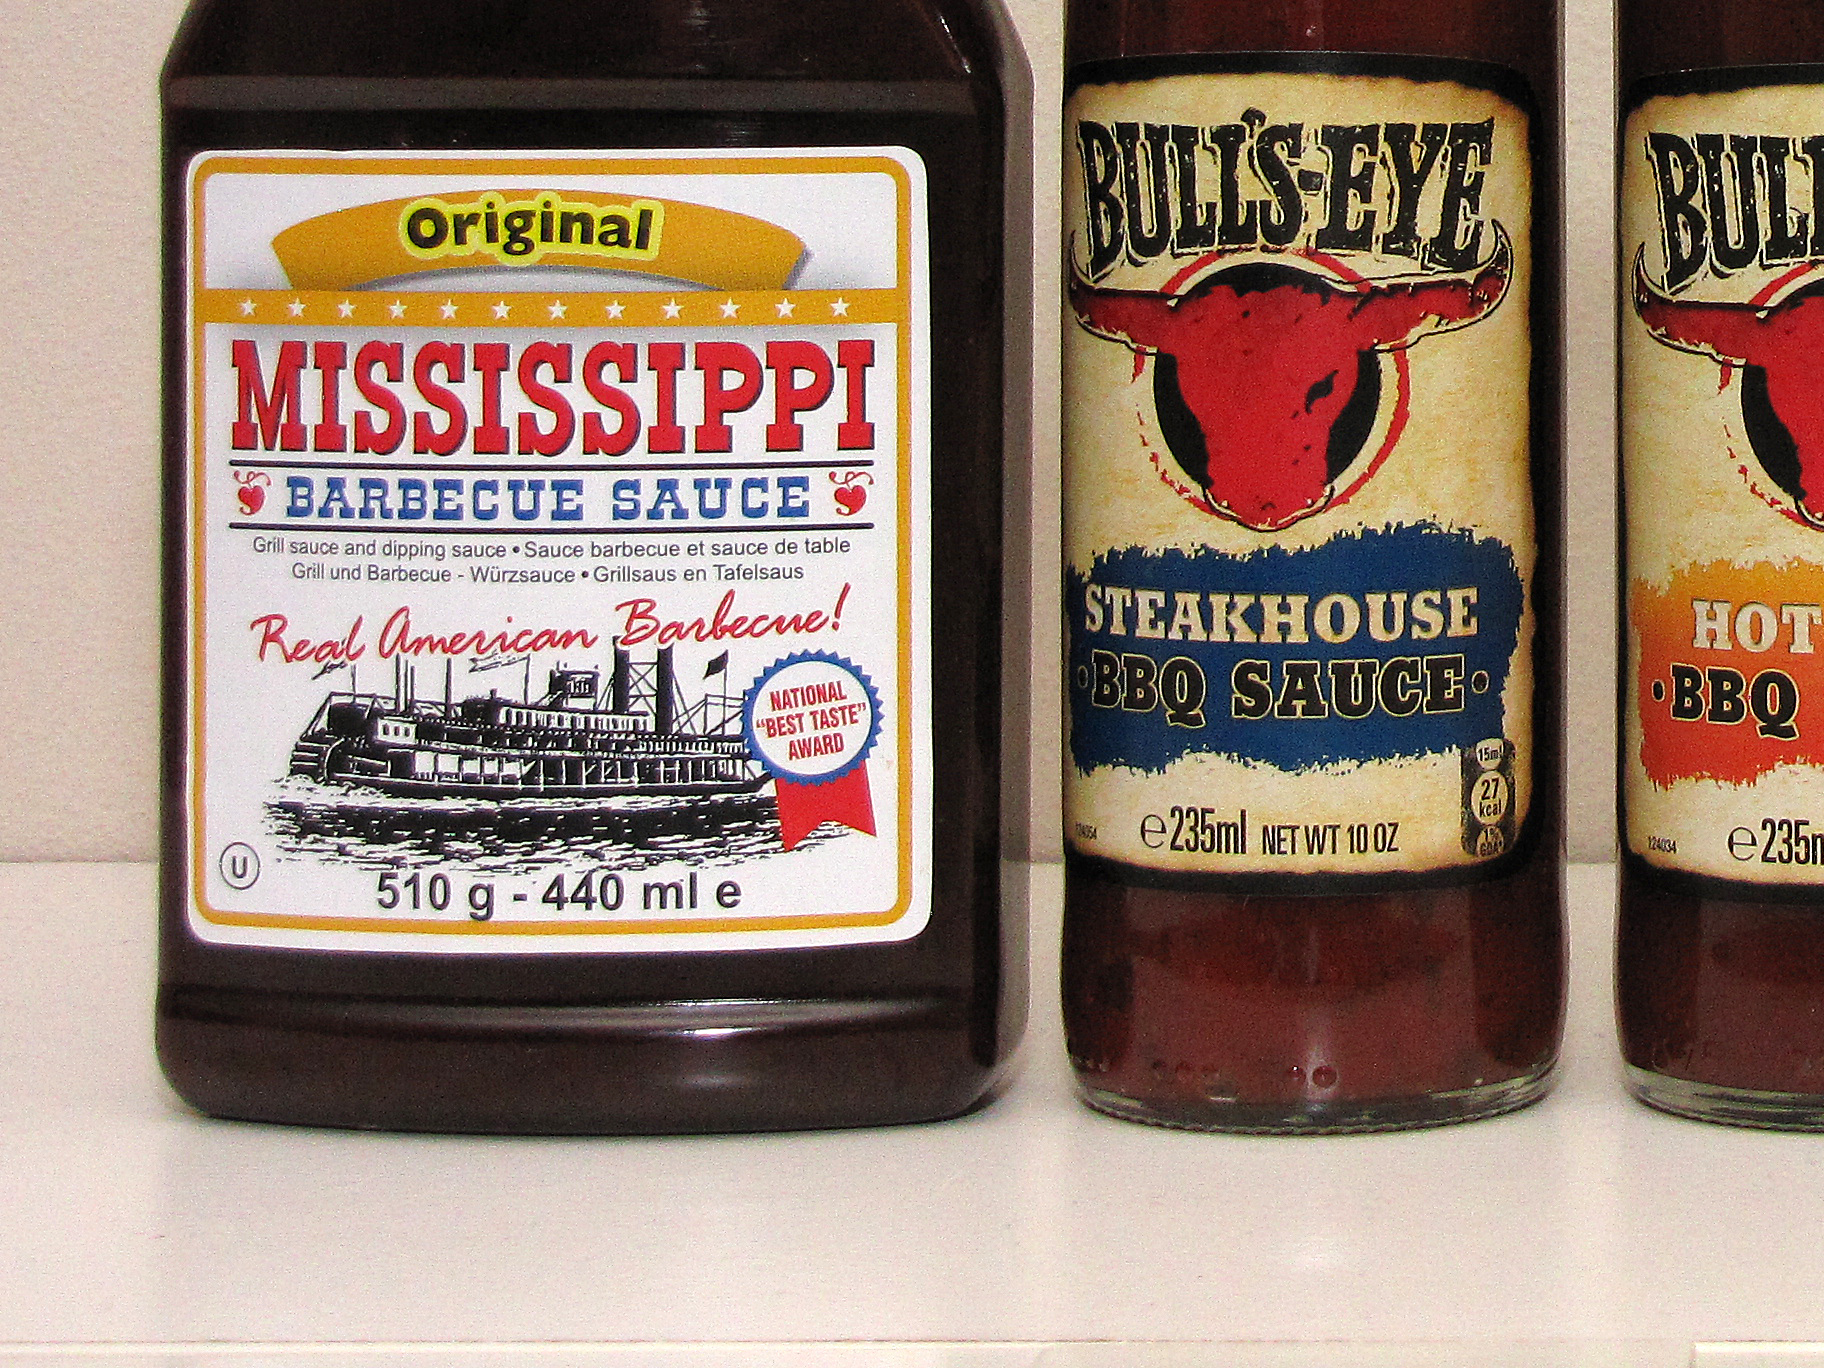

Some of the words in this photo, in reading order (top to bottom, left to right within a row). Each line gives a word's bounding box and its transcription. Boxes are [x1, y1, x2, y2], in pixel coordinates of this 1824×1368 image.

[406, 200, 655, 255] Original
[231, 339, 875, 455] MISSISSIPPI
[286, 476, 585, 522] BARBECUE
[612, 476, 811, 521] SAUCE
[253, 536, 284, 554] Grill
[290, 539, 338, 555] sauce
[345, 540, 377, 556] and
[382, 540, 446, 561] dipping
[452, 543, 506, 558] sauce
[524, 541, 584, 558] Sauce
[591, 541, 680, 557] barbecue
[687, 541, 705, 557] et
[711, 540, 768, 556] sauce
[775, 538, 798, 554] de
[805, 536, 851, 554] table
[292, 562, 324, 580] Grill
[330, 564, 362, 581] und
[368, 564, 451, 582] Barbecue
[470, 566, 575, 583] Würzsauce
[593, 565, 677, 583] Grillsaus
[683, 568, 707, 582] en
[713, 563, 804, 581] Tafelsaus
[250, 613, 366, 663] Real
[378, 605, 598, 658] American
[615, 582, 851, 646] Barbecue!
[1084, 585, 1480, 643] STEAKHOUSE
[1692, 598, 1823, 654] HOT
[769, 680, 847, 712] NATIONAL
[1092, 650, 1207, 728] BBQ
[1232, 654, 1465, 719] SAUCE
[1670, 663, 1800, 740] BBQ
[788, 732, 844, 761] AWARD
[1479, 745, 1503, 762] 15ml
[1479, 798, 1502, 817] kcal
[1481, 777, 1500, 800] 27
[1263, 824, 1300, 855] NET
[1304, 824, 1341, 855] WT
[1347, 823, 1369, 854] 10
[1374, 822, 1400, 852] OZ
[376, 871, 451, 911] 510
[468, 879, 496, 921] g
[541, 871, 626, 911] 440
[643, 871, 698, 910] ml
[716, 879, 743, 909] e
